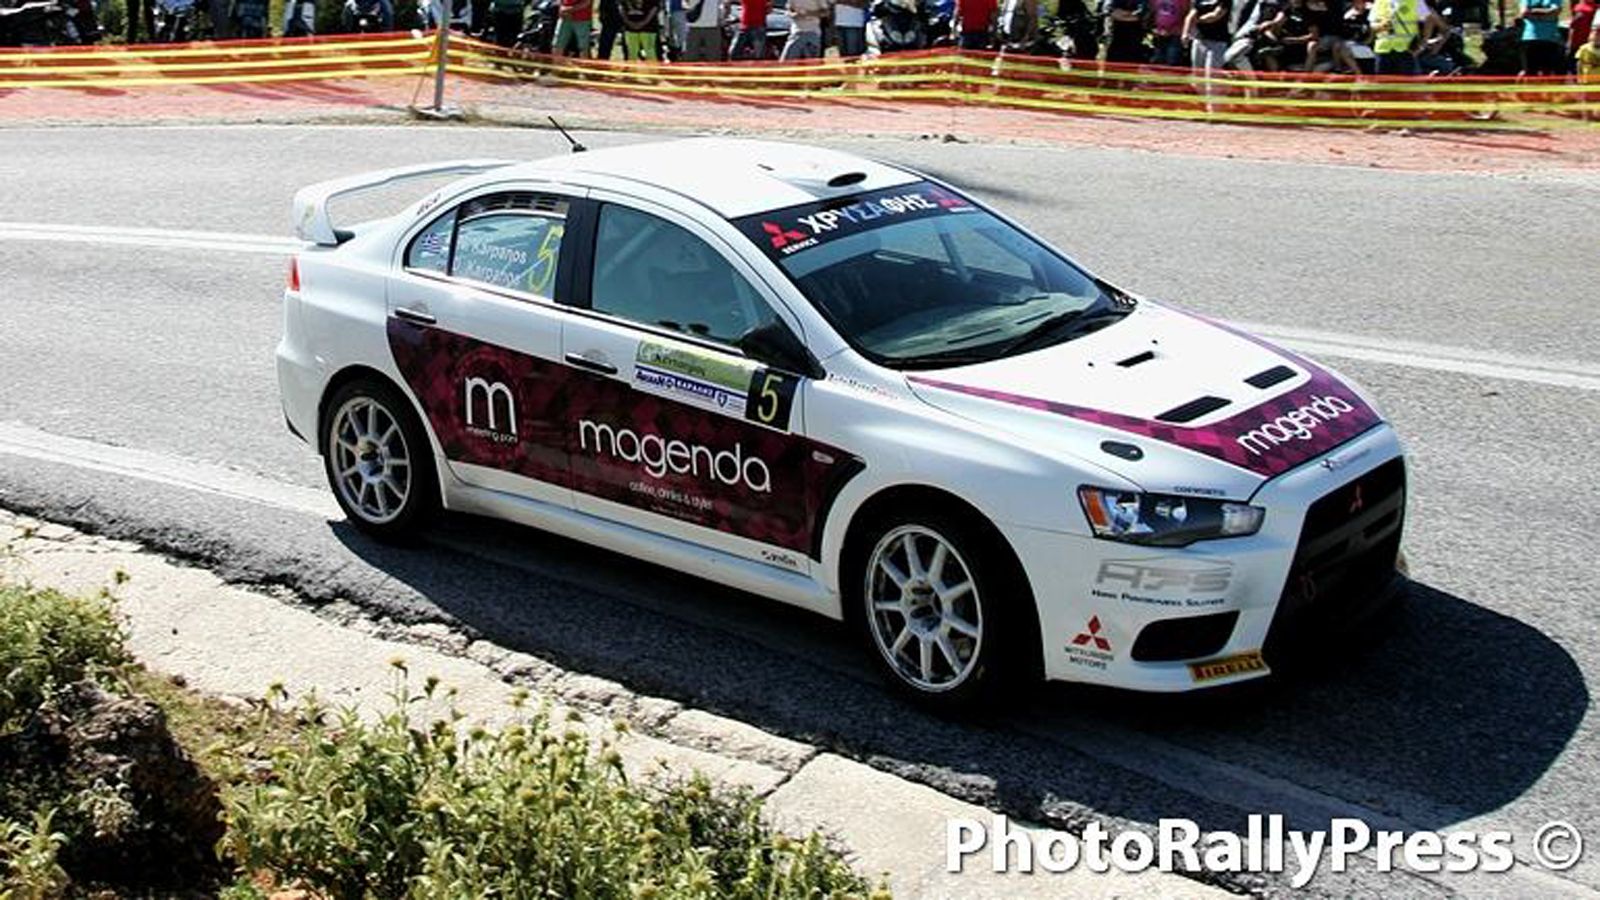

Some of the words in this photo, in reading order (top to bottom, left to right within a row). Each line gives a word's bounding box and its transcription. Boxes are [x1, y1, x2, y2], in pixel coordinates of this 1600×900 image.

[528, 225, 564, 292] 5
[464, 376, 517, 434] m
[757, 373, 783, 423] 5
[1236, 394, 1355, 456] magenda
[578, 419, 772, 493] magenda
[1069, 654, 1107, 671] MOTORS
[1191, 652, 1265, 681] PIRELLI
